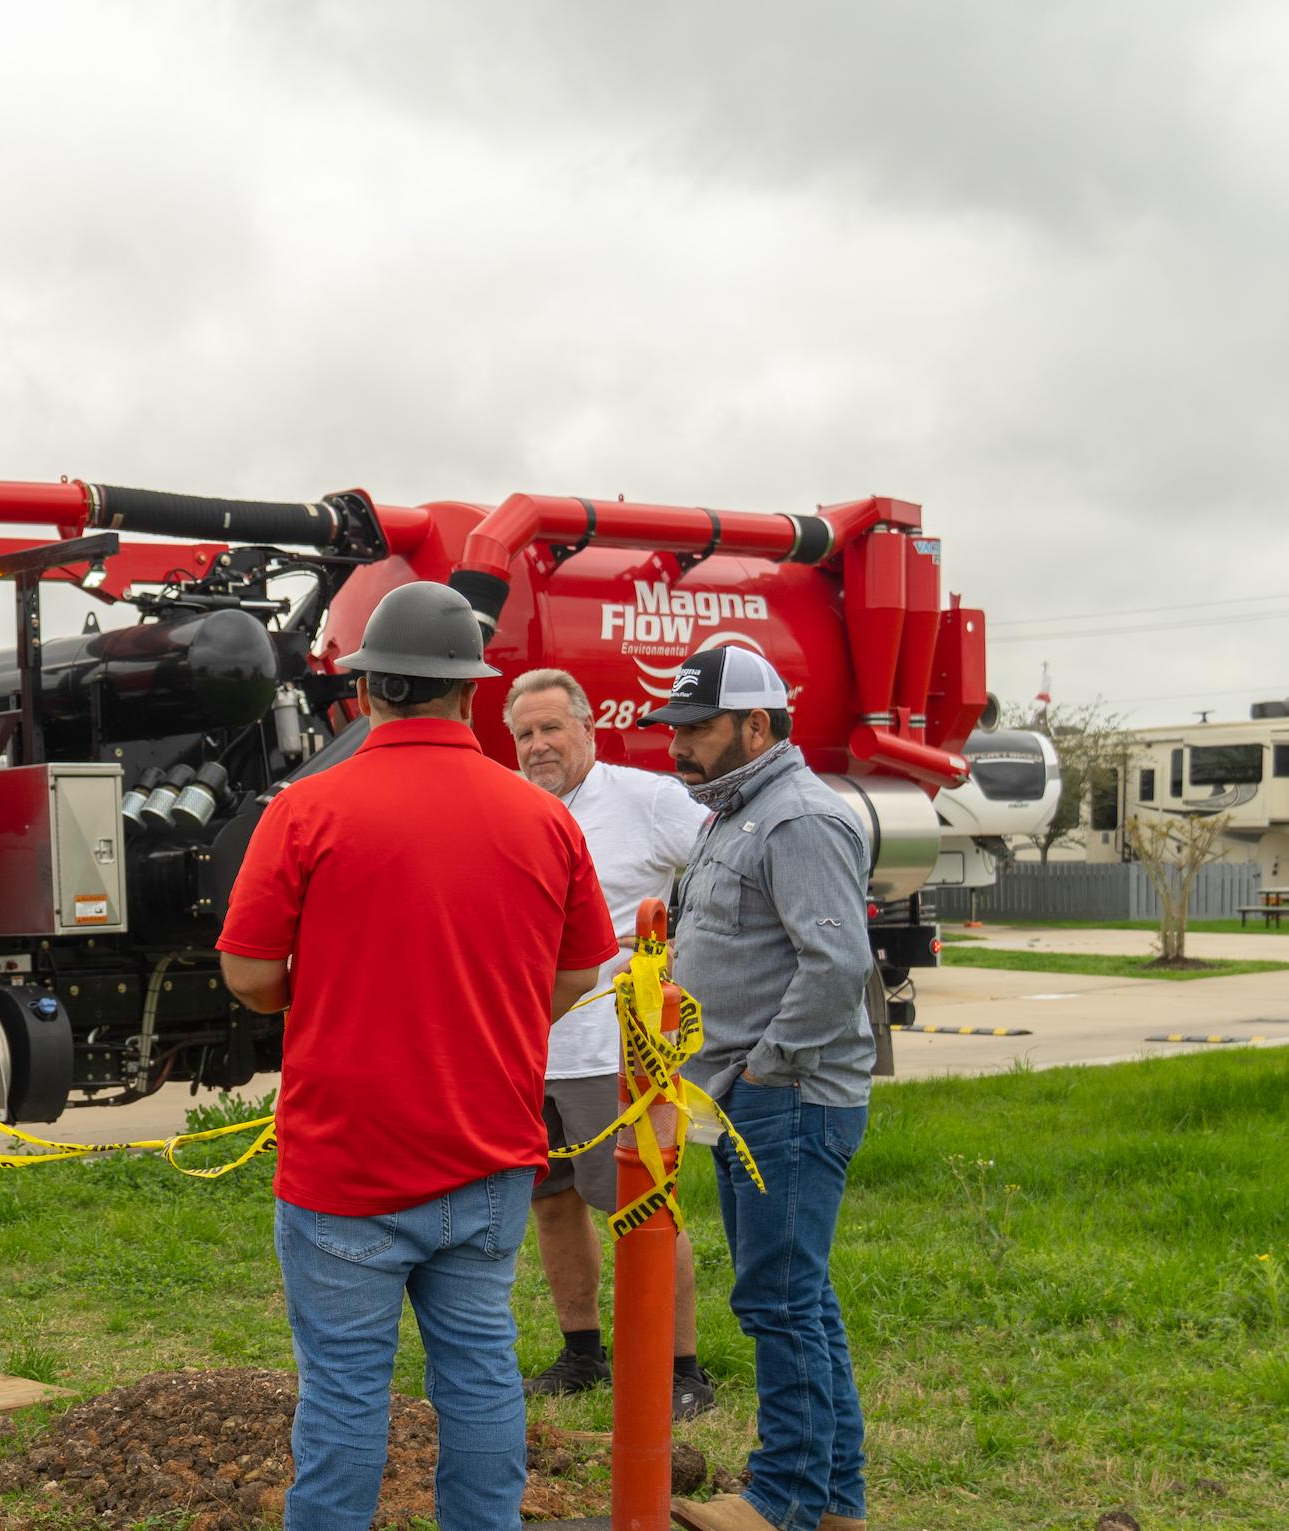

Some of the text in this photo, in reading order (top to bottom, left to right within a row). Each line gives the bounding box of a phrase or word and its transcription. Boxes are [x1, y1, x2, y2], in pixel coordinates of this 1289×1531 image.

[600, 603, 695, 644] Flow
[633, 580, 769, 627] Magna
[621, 642, 688, 657] Environmental
